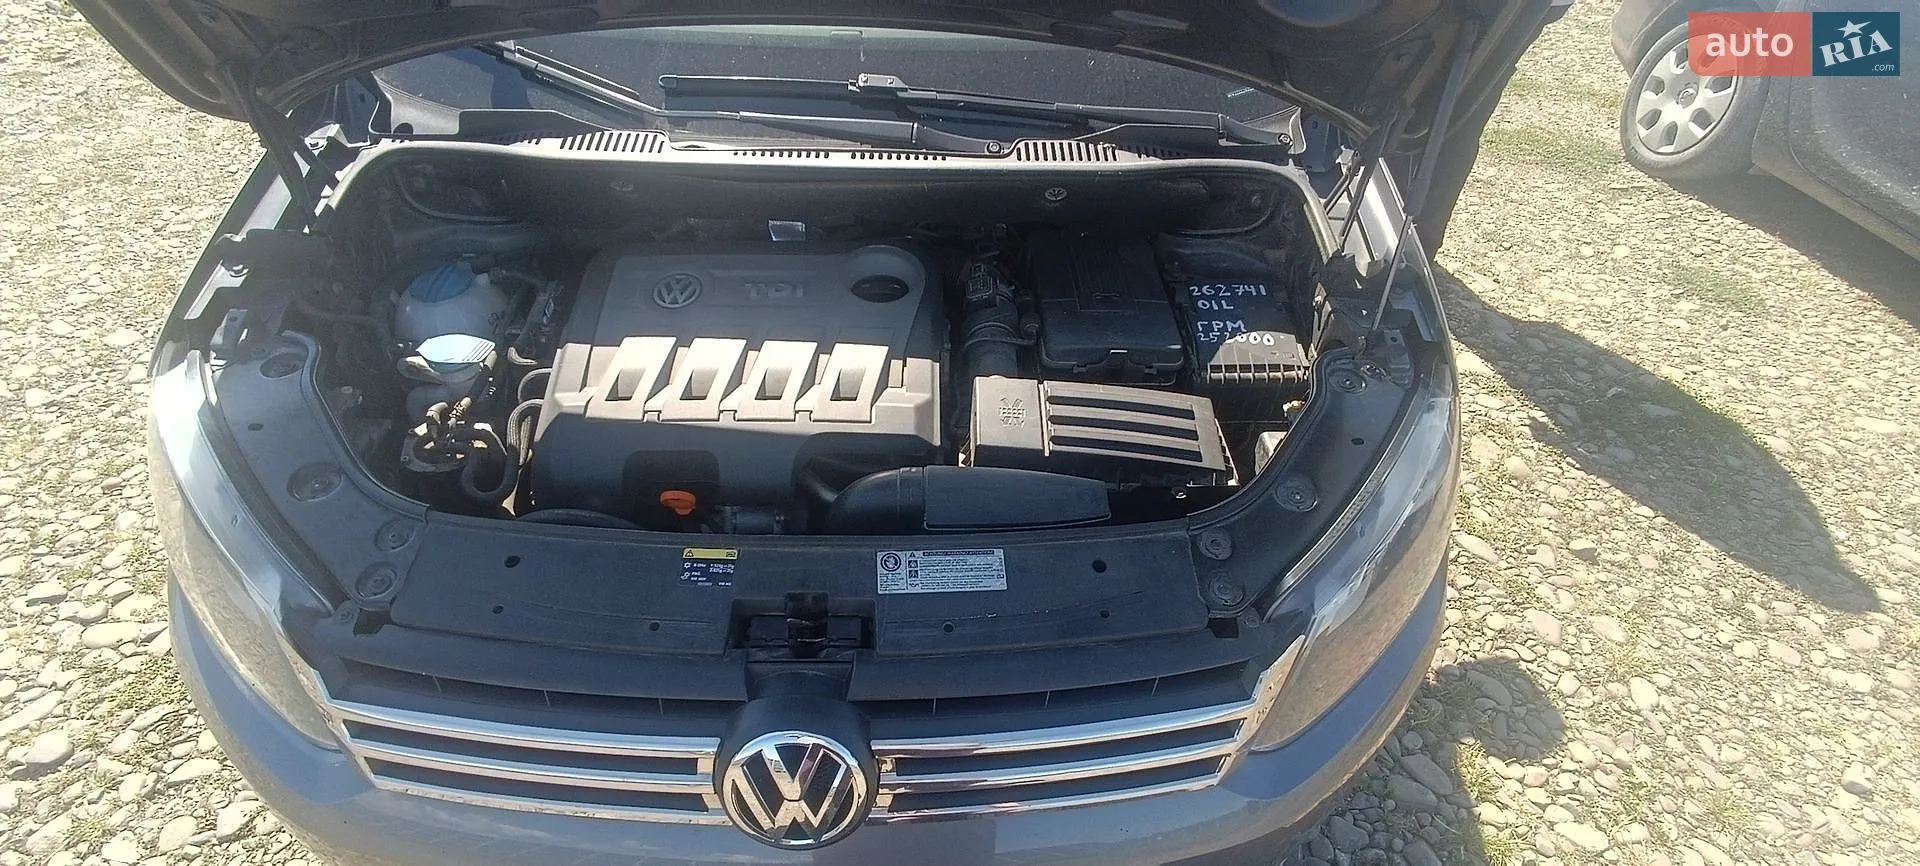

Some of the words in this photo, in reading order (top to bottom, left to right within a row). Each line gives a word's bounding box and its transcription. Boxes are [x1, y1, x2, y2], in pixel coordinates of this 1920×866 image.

[653, 272, 702, 308] VW
[745, 281, 804, 297] TDI
[1197, 299, 1234, 310] OIL
[724, 732, 867, 848] VW
